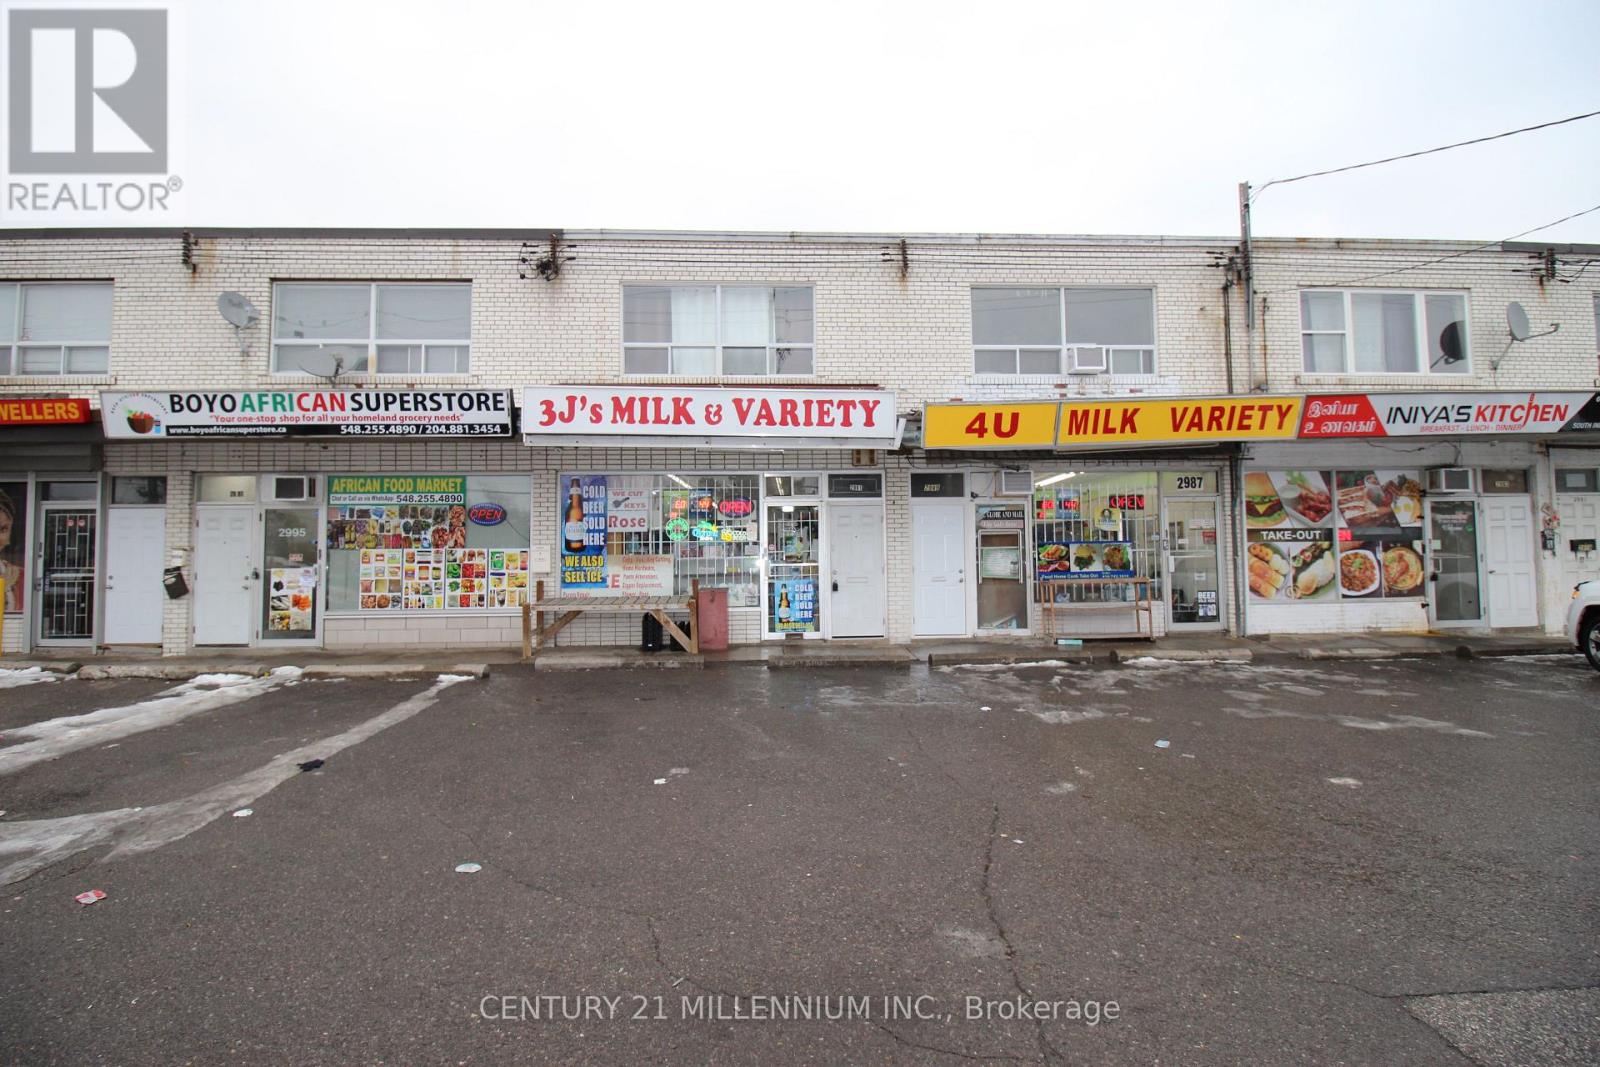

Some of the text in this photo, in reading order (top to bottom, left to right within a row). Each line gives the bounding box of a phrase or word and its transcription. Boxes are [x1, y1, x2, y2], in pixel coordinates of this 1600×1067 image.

[170, 394, 237, 413] BOYO
[240, 393, 345, 413] AFRICAN
[351, 392, 505, 412] SUPERSTORE
[539, 395, 881, 427] 3J's MILK & VARIETY
[1386, 405, 1472, 424] INIYA'S
[237, 414, 276, 425] one-stop
[280, 414, 300, 424] shop
[302, 413, 314, 422] for
[317, 413, 329, 422] all
[331, 415, 350, 424] your
[352, 414, 396, 422] homeland
[399, 414, 432, 425] grocery
[1067, 404, 1293, 436] MILK VARIETY
[170, 426, 286, 435] www.boyoafricansuperstore.ca
[340, 424, 416, 434] 548.255.4890
[425, 424, 501, 434] 204.881.3454
[333, 479, 463, 493] AFRICAN FOOD MARKET
[1177, 477, 1203, 489] 2987
[583, 486, 605, 498] COLD
[397, 495, 462, 503] 548.255.4890
[1111, 496, 1144, 508] OPEN
[583, 502, 604, 514] BEER
[719, 500, 752, 513] OPEN
[470, 509, 502, 519] OPEN
[583, 517, 605, 529] SOLD
[609, 516, 645, 528] Rose
[279, 529, 306, 537] 2995
[583, 533, 605, 545] HERE
[1261, 531, 1321, 543] TAKE-OUT
[565, 556, 604, 567] WE ALSO
[565, 570, 602, 583] SELL ICE
